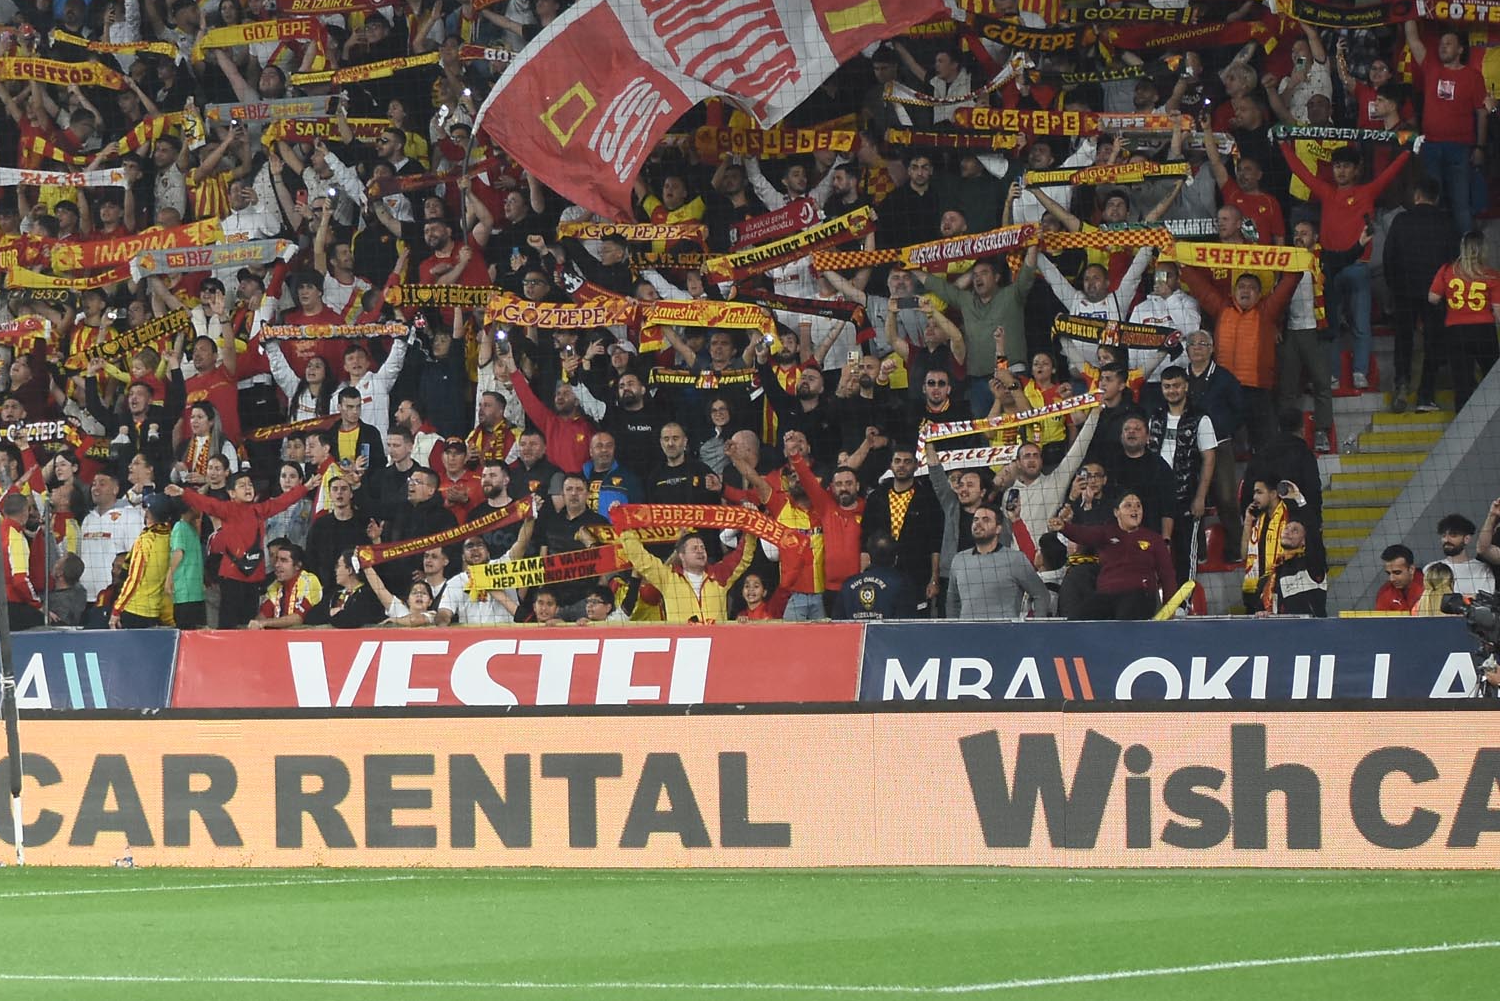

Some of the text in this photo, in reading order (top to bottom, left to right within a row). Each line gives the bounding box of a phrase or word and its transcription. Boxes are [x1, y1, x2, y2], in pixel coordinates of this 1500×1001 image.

[1362, 127, 1394, 141] DOST
[805, 223, 846, 247] TAYFA
[1446, 278, 1489, 309] 35
[504, 303, 604, 326] GÖZTEPE
[651, 508, 705, 521] FORZA
[485, 551, 601, 576] HER ZAMAN VARDIK
[493, 577, 516, 589] HEP
[959, 722, 1321, 850] Wish
[274, 751, 792, 849] RENTAL
